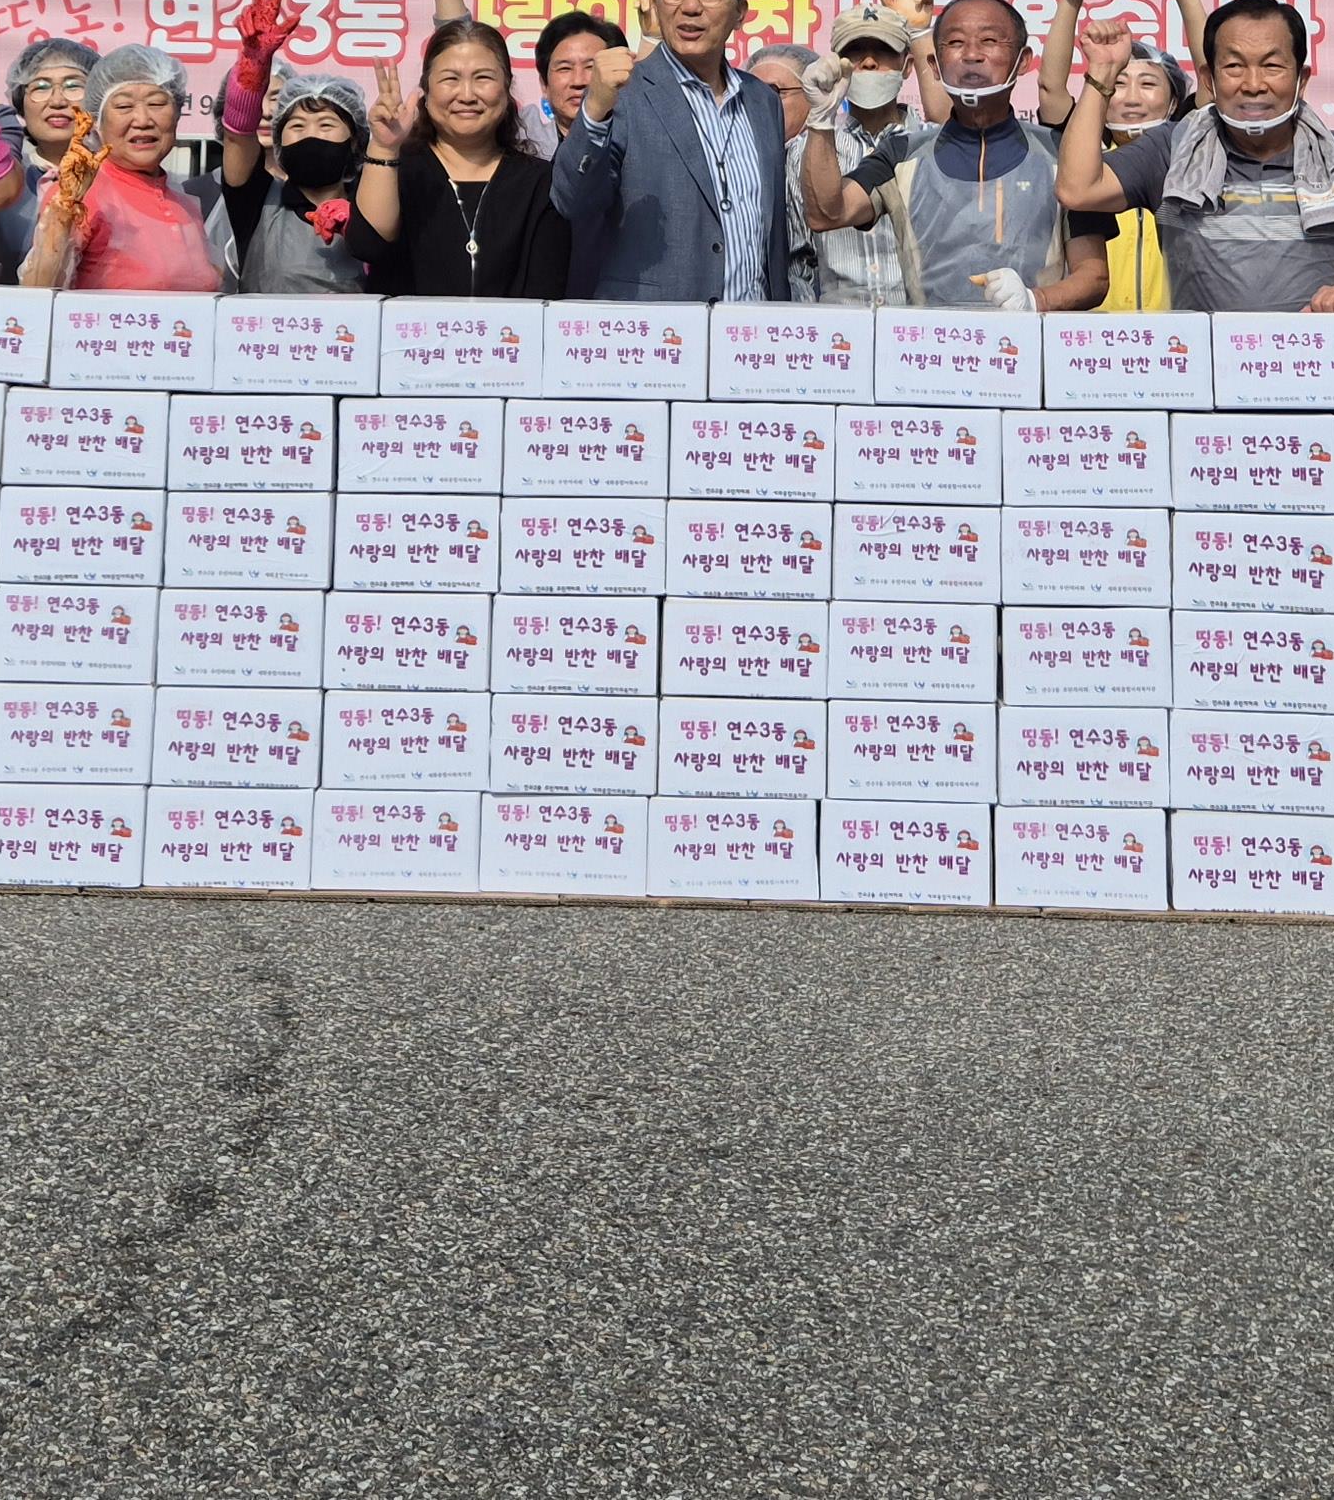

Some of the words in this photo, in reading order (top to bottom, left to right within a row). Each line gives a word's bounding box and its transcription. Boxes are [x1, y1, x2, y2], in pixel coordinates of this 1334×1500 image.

[230, 316, 263, 333] 띵동!
[271, 316, 324, 335] 연수3동
[725, 325, 758, 343] 띵동!
[766, 325, 820, 344] 연수3동
[237, 343, 280, 361] 사랑의
[288, 343, 319, 362] 반찬
[325, 344, 355, 363] 배달
[1229, 332, 1263, 352] 띵동!
[1271, 332, 1326, 351] 연수3동
[734, 352, 776, 371] 사랑의
[785, 352, 815, 371] 반찬
[822, 352, 851, 371] 배달
[1239, 360, 1283, 379] 사랑의
[1292, 359, 1323, 378] 반찬
[691, 419, 729, 440] 띵동!
[737, 420, 797, 443] 연수3동
[1194, 435, 1233, 456] 띵동!
[1241, 435, 1302, 456] 연수3동
[686, 451, 733, 471] 사랑의
[742, 451, 776, 473] 반찬
[784, 454, 818, 475] 배달
[1190, 466, 1238, 487] 사랑의
[1248, 466, 1283, 487] 반찬
[1291, 467, 1324, 487] 배달
[355, 513, 392, 533] 띵동!
[401, 513, 462, 533] 연수3동
[688, 521, 725, 543] 띵동!
[734, 522, 794, 544] 연수3동
[349, 543, 397, 564] 사랑의
[406, 542, 441, 564] 반찬
[448, 543, 482, 564] 배달
[682, 554, 730, 574] 사랑의
[739, 553, 774, 575] 반찬
[781, 554, 816, 575] 배달
[344, 613, 383, 635] 띵동!
[390, 615, 451, 638] 연수3동
[684, 624, 723, 645] 띵동!
[731, 626, 791, 646] 연수3동
[1195, 629, 1234, 651] 띵동!
[1242, 630, 1306, 653] 연수3동
[336, 645, 385, 666] 사랑의
[394, 647, 429, 668] 반찬
[436, 649, 470, 670] 배달
[678, 656, 727, 677] 사랑의
[737, 657, 772, 677] 반찬
[779, 657, 813, 678] 배달
[1189, 661, 1239, 683] 사랑의
[1249, 662, 1284, 684] 반찬
[1292, 663, 1327, 686] 배달
[680, 719, 718, 741] 띵동!
[726, 721, 787, 743] 연수3동
[673, 751, 722, 773] 사랑의
[732, 753, 767, 775] 반찬
[774, 754, 809, 775] 배달
[44, 808, 105, 830] 연수3동
[330, 804, 364, 823] 띵동!
[372, 804, 427, 824] 연수3동
[841, 819, 880, 841] 띵동!
[888, 820, 951, 843] 연수3동
[48, 839, 82, 862] 반찬
[90, 842, 124, 863] 배달
[337, 833, 382, 852] 사랑의
[390, 834, 421, 852] 반찬
[428, 834, 459, 853] 배달
[835, 851, 884, 873] 사랑의
[895, 852, 929, 875] 반찬
[937, 854, 972, 877] 배달
